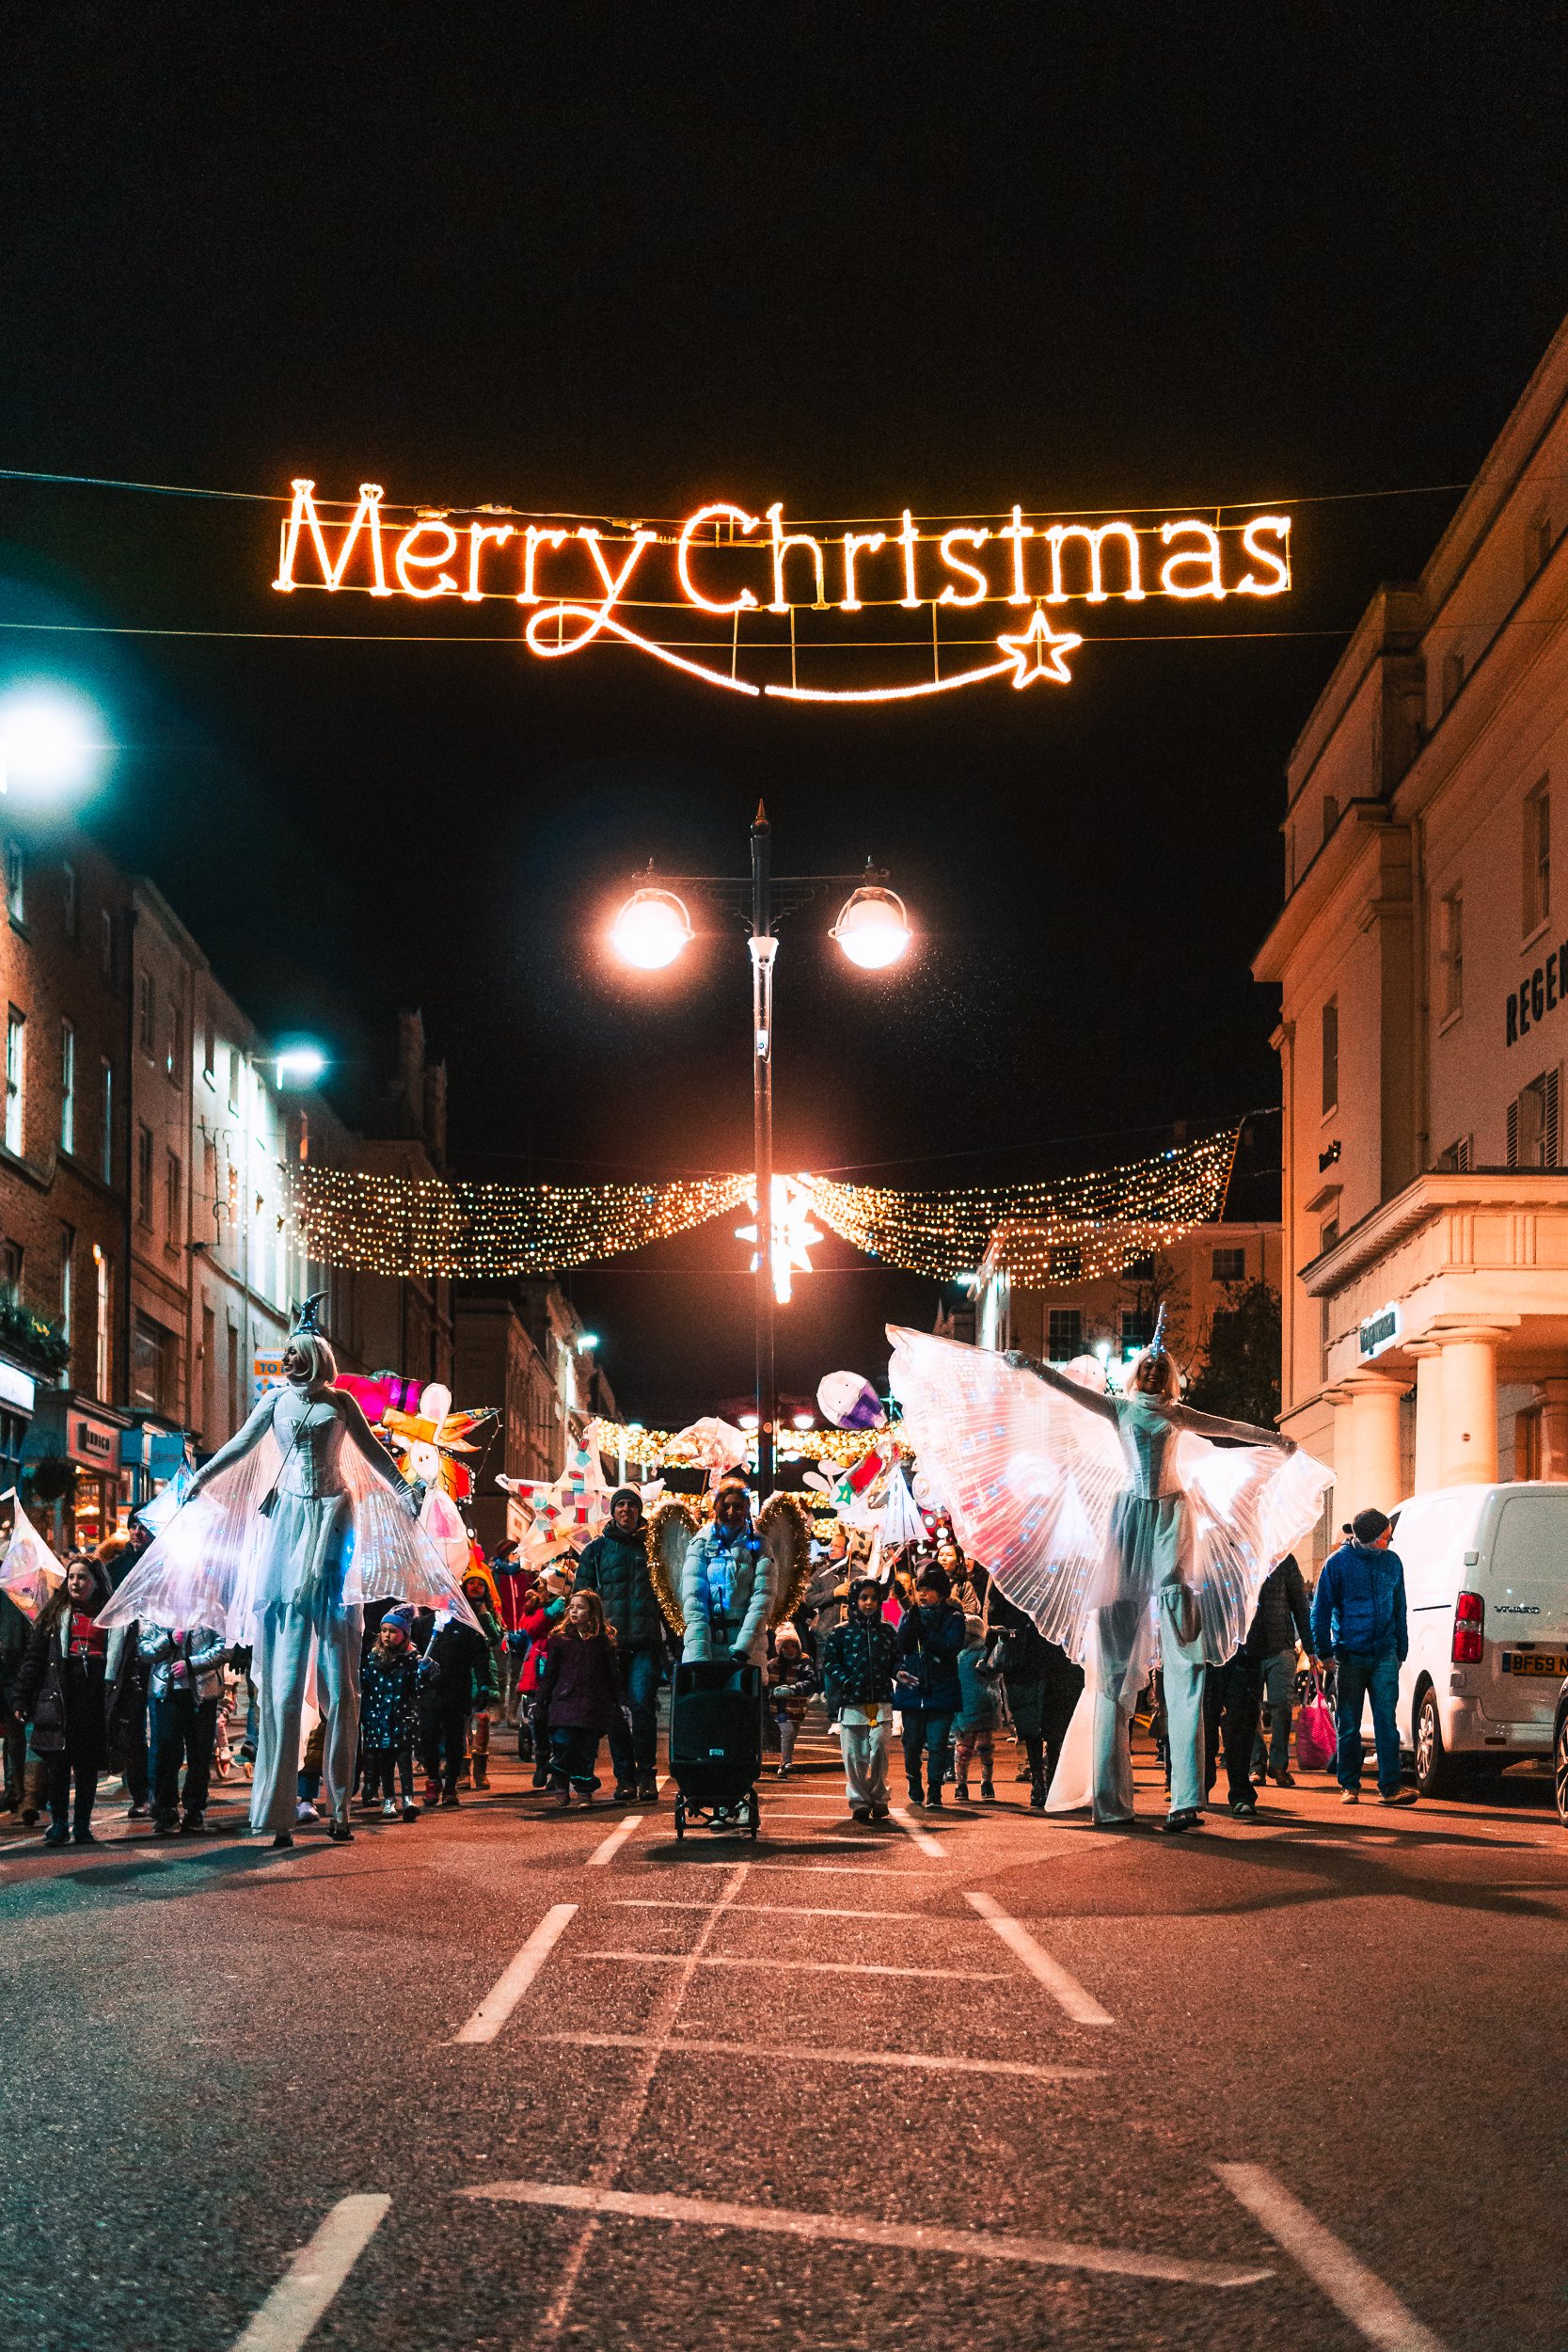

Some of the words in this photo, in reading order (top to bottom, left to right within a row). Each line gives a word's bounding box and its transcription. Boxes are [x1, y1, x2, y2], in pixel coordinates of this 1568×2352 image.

[271, 478, 660, 659] Merry
[676, 502, 1291, 613] Christmas
[259, 1362, 277, 1374] TO
[1494, 1605, 1541, 1614] VIVARO
[1513, 1655, 1555, 1672] BF69
